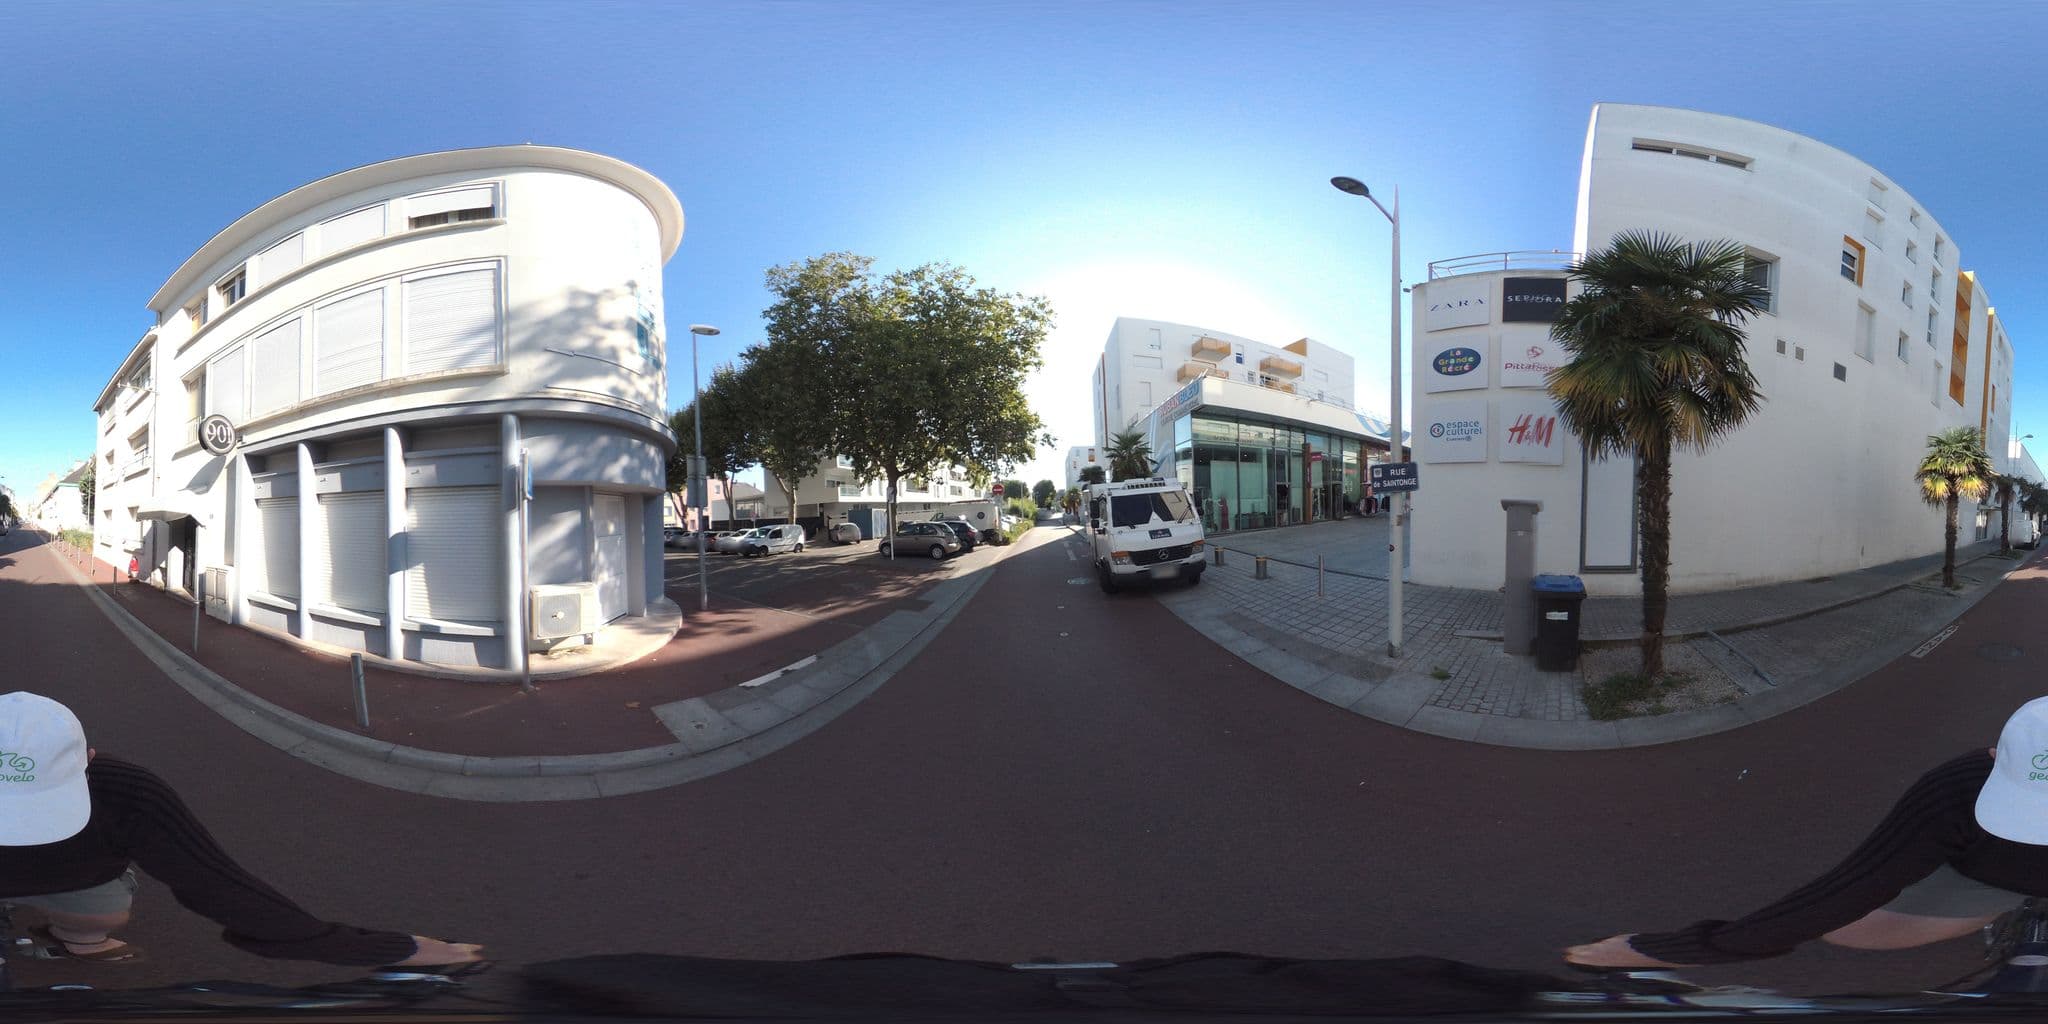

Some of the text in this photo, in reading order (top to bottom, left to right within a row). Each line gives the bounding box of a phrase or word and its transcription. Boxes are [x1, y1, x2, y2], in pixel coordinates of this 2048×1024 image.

[1430, 299, 1484, 311] ZARA
[1439, 356, 1474, 366] Grande
[1446, 420, 1480, 431] espace
[1508, 413, 1555, 449] H&M
[1446, 427, 1482, 436] culturel
[1390, 468, 1407, 476] RUE
[1382, 477, 1417, 488] SAINTONGE
